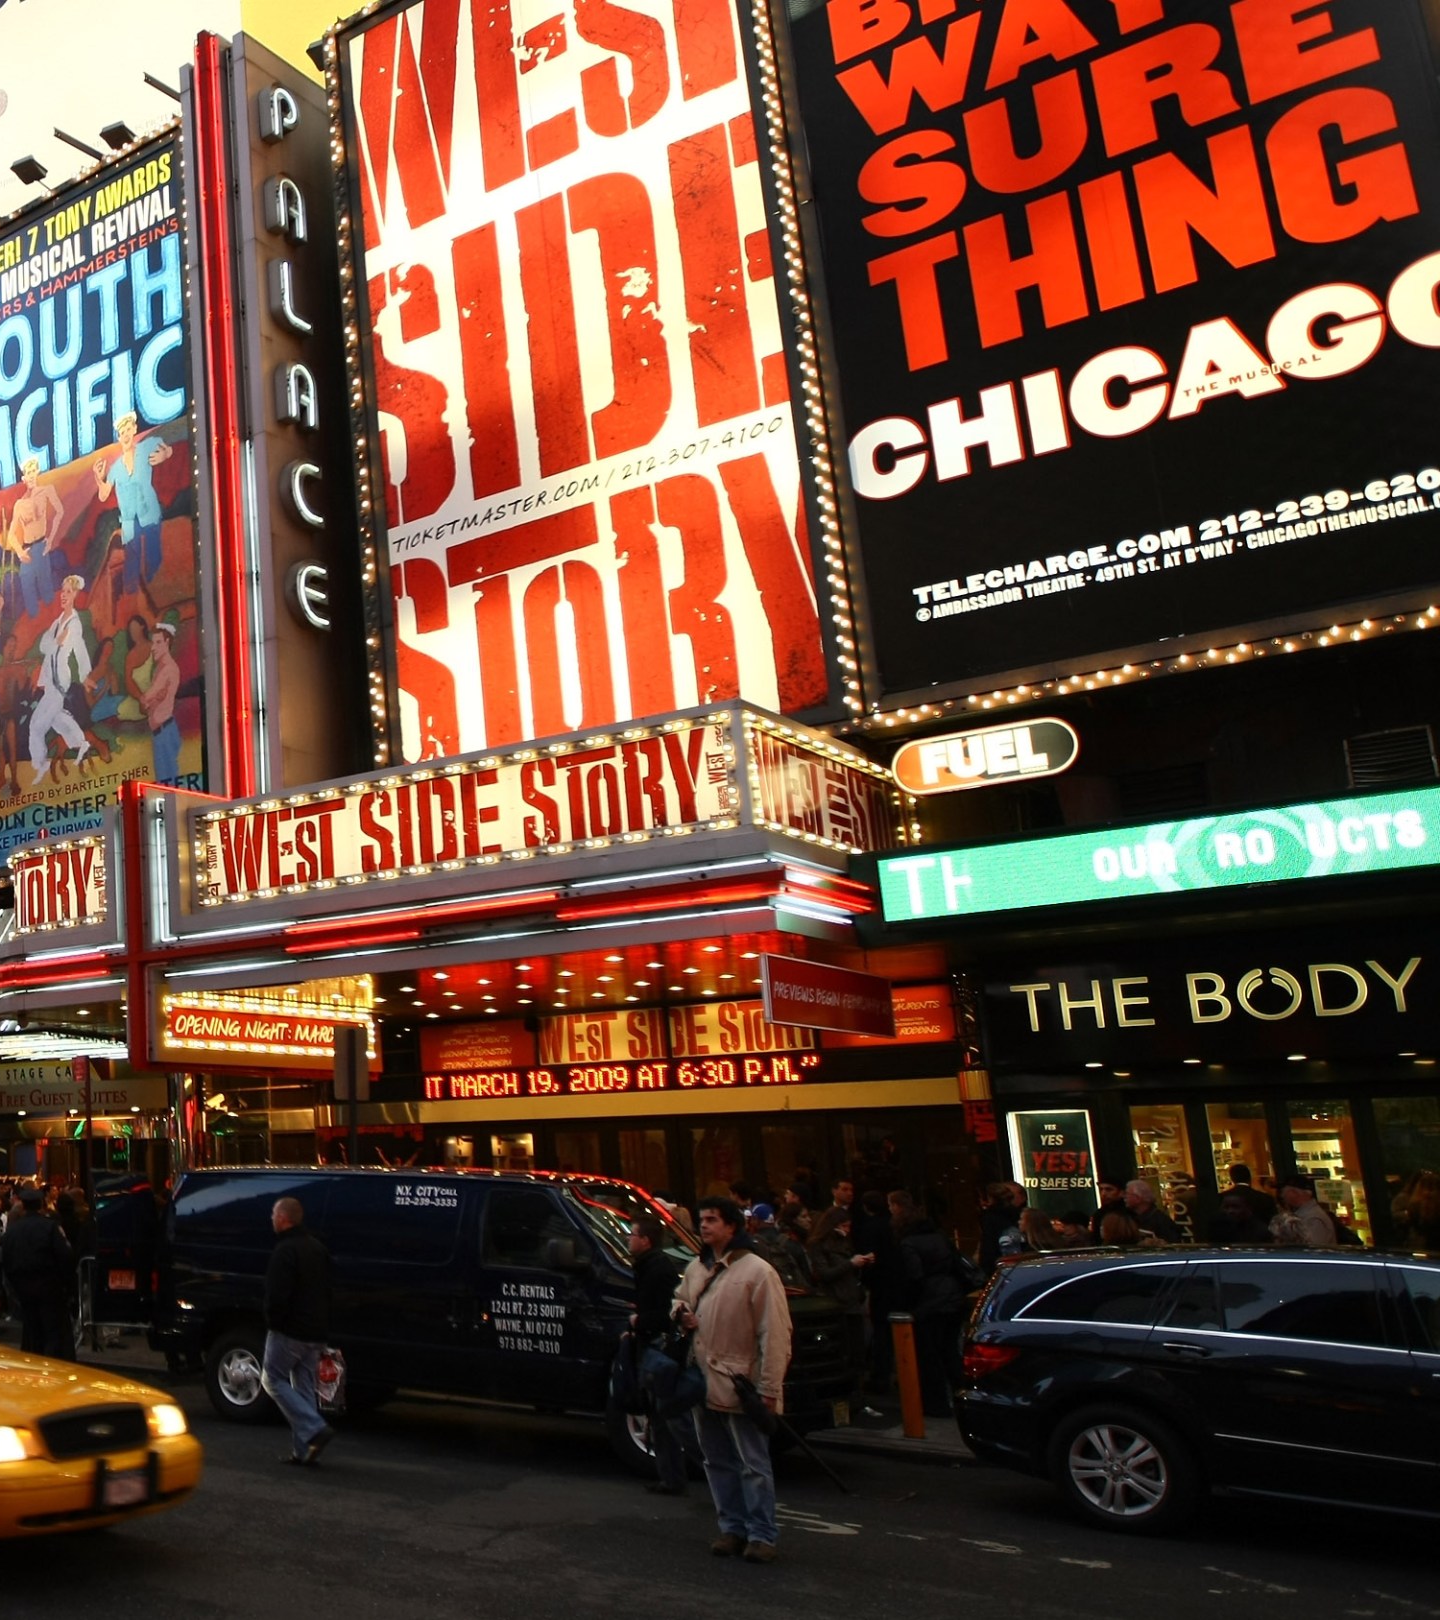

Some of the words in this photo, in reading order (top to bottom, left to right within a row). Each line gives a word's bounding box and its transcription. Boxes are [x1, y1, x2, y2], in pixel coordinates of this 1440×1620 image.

[857, 0, 1382, 238] SURE
[27, 225, 39, 256] 7
[44, 196, 92, 246] TONY
[94, 151, 173, 220] AWARDS
[1, 233, 86, 304] MUSICAL
[91, 185, 176, 256] REVIVAL
[866, 86, 1421, 373] THING
[25, 292, 36, 308] &
[40, 217, 179, 300] HAMMERSTEIN'S
[366, 110, 790, 528] SIDE
[260, 86, 331, 630] PALACE
[1182, 381, 1220, 399] THE
[1227, 353, 1323, 386] MUSICAL
[393, 470, 602, 554] TICKETMASTER.COM
[622, 416, 785, 482] 212-307-4100
[912, 525, 1192, 605] TELECHARGE.COM
[932, 586, 1023, 620] AMBASSADOR
[1024, 571, 1086, 599] THEATRE
[1095, 560, 1135, 583] 49TH
[1137, 556, 1160, 576] ST.
[1163, 549, 1182, 569] AT
[1185, 538, 1234, 565] B'WAY
[389, 452, 828, 768] STORY
[706, 751, 729, 785] WEST
[917, 727, 1049, 786] FUEL
[0, 788, 46, 810] DIRECTED
[48, 786, 62, 799] BY
[64, 773, 120, 797] BARTLETT
[122, 765, 150, 782] SHER
[31, 793, 107, 827] CENTER
[219, 798, 346, 894] WEST
[359, 769, 502, 876] SIDE
[521, 727, 706, 848] STORY
[12, 832, 35, 846] THE
[49, 817, 103, 837] SUBWAY
[1091, 839, 1177, 884] OUR
[773, 981, 816, 1003] PREVIEWS
[1009, 976, 1156, 1032] THE
[1184, 957, 1423, 1024] BODY
[175, 1014, 242, 1038] OPENING
[244, 1021, 292, 1041] NIGHT:
[539, 1012, 618, 1065] WEST
[626, 1005, 709, 1059] SIDE
[6, 1066, 44, 1081] STAGE
[450, 1072, 520, 1098] MARCH
[526, 1070, 560, 1095] 19,
[568, 1066, 630, 1093] 2009
[637, 1064, 669, 1088] AT
[677, 1060, 736, 1087] 6:30
[29, 1089, 74, 1107] GUEST
[1040, 1134, 1064, 1146] YES
[1044, 1123, 1057, 1131] YES
[1024, 1177, 1039, 1188] TO
[1040, 1177, 1069, 1188] SAFE
[1069, 1177, 1092, 1188] SEX
[1031, 1151, 1089, 1173] YES!
[395, 1186, 412, 1196] N.Y.
[416, 1186, 441, 1196] CITY
[395, 1197, 458, 1207] 212-239-3333
[491, 1301, 512, 1314] 1241
[512, 1303, 526, 1316] RT.
[527, 1304, 538, 1316] 23
[540, 1304, 566, 1319] SOUTH
[502, 1283, 519, 1297] C.C.
[520, 1284, 555, 1300] RENTALS
[494, 1318, 525, 1334] WAYNE,
[525, 1321, 535, 1334] NJ
[536, 1322, 564, 1337] 07470
[499, 1336, 515, 1350] 973
